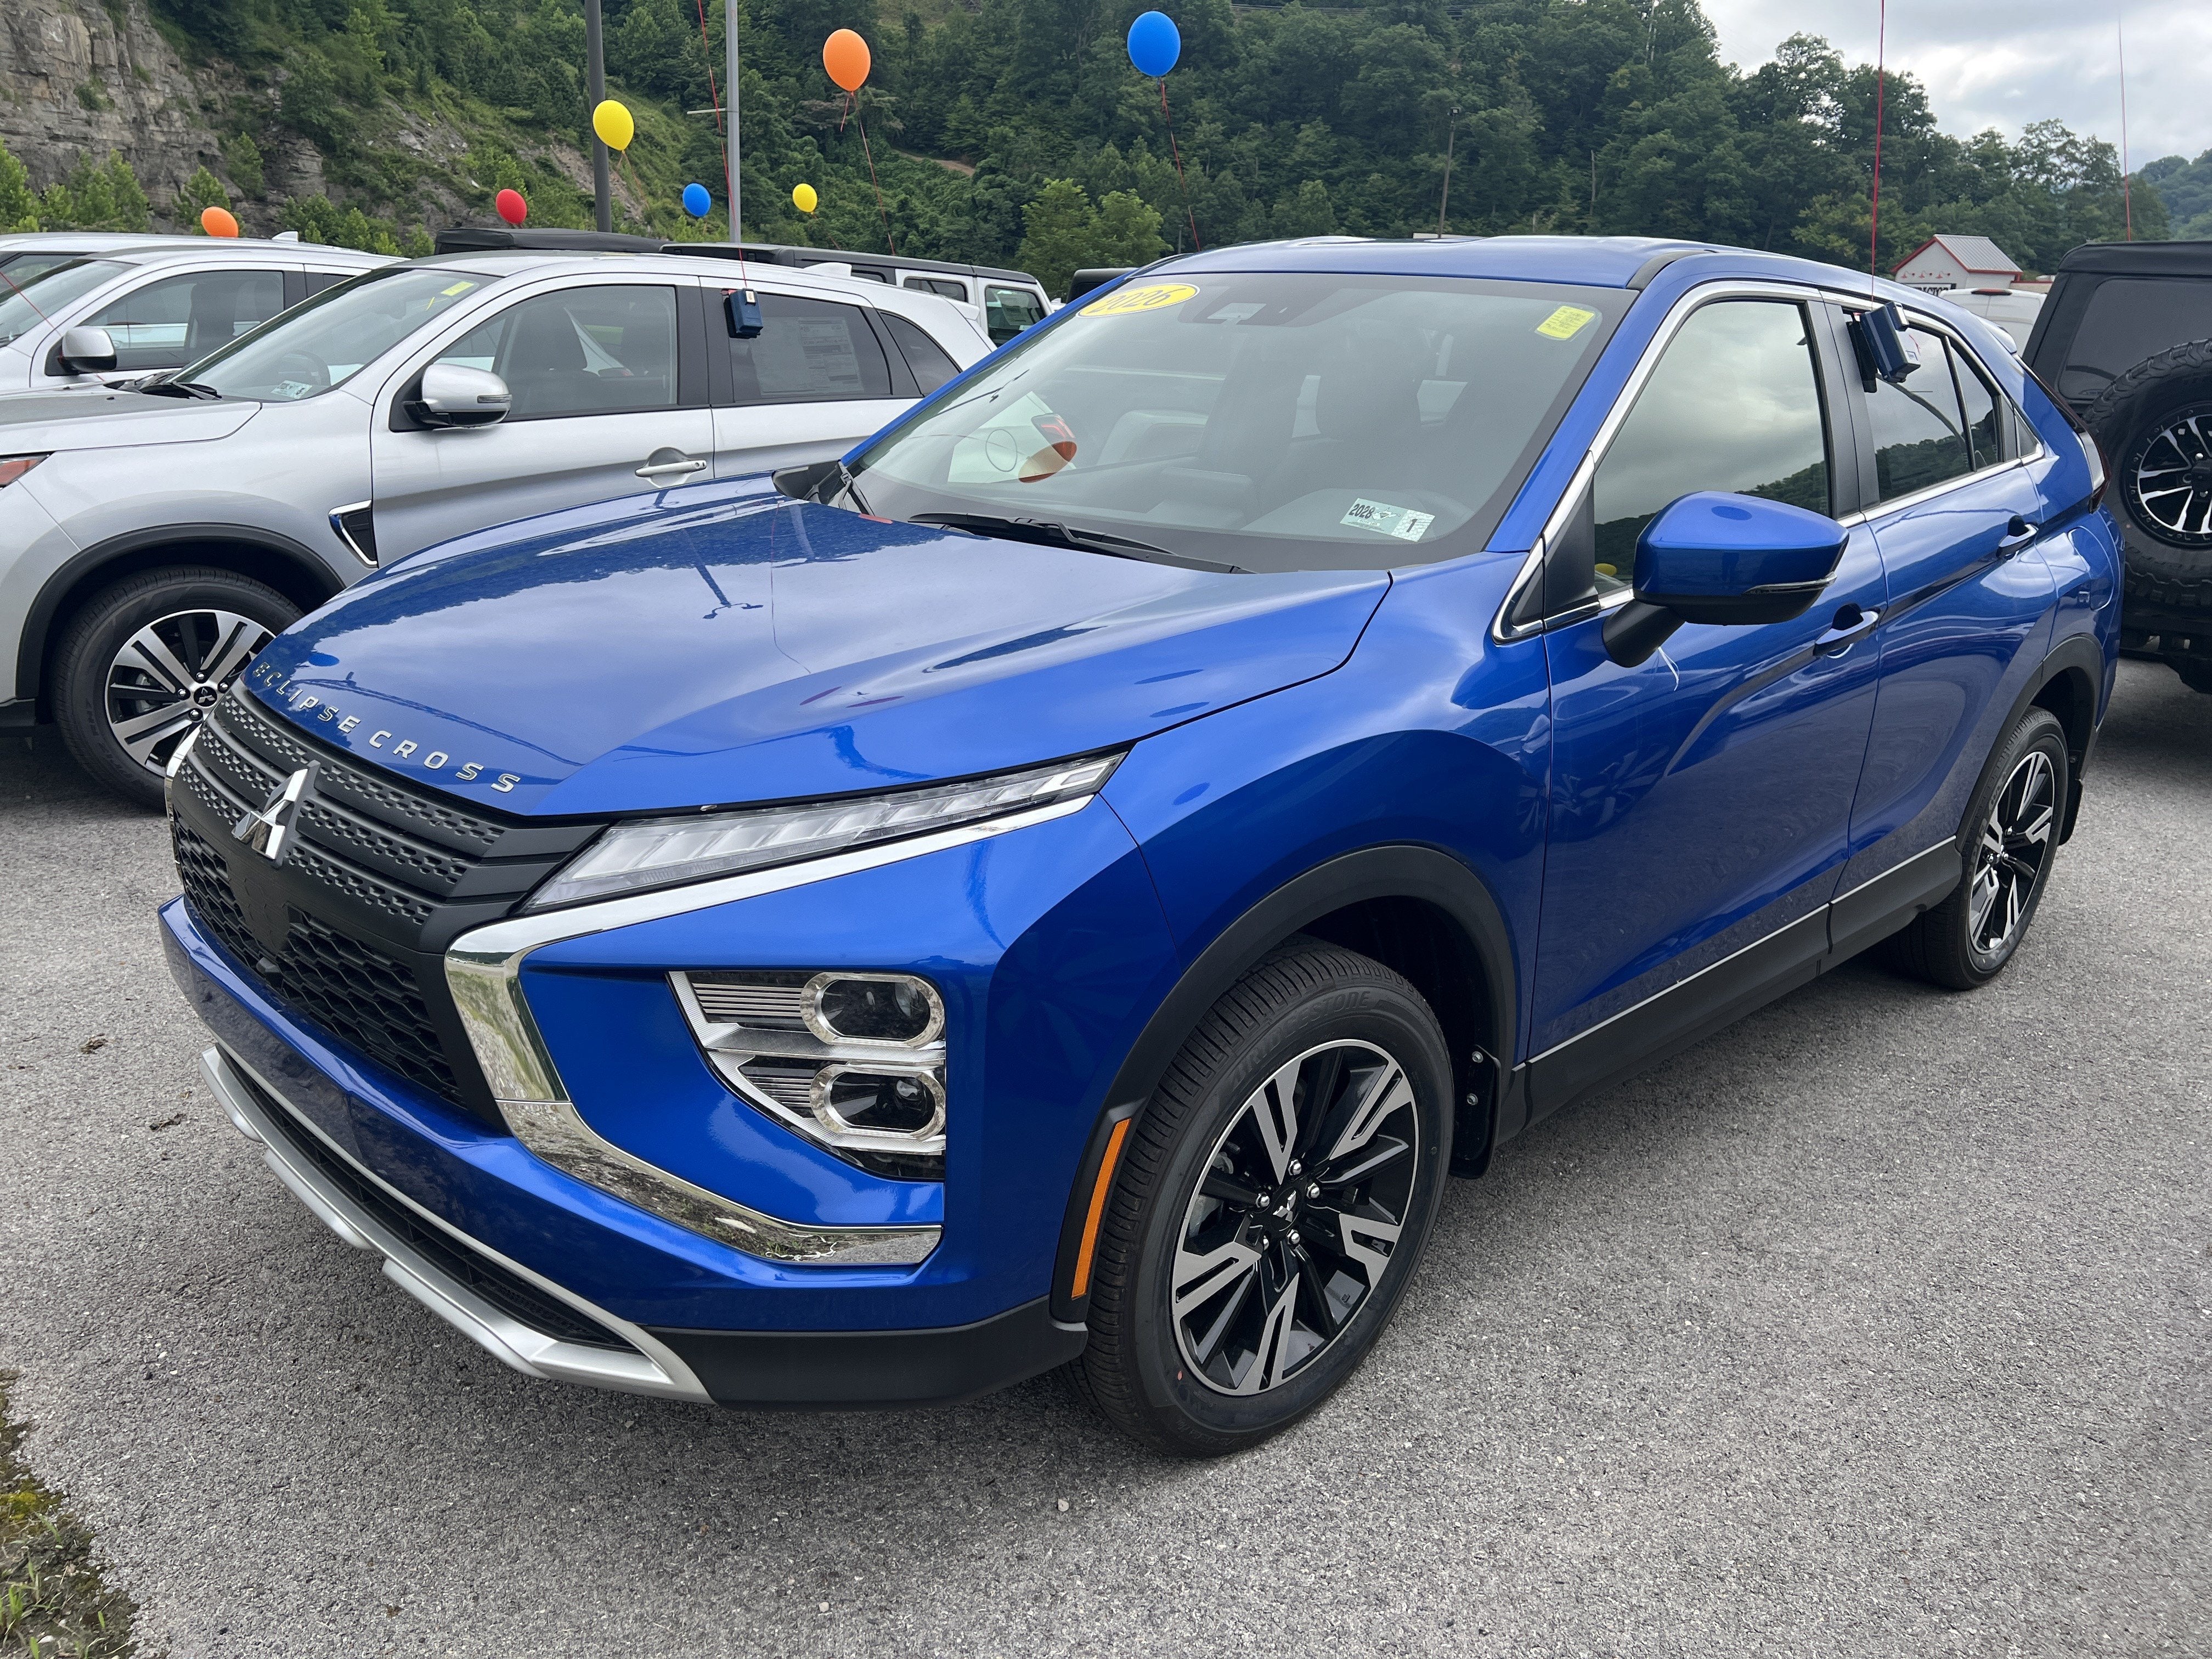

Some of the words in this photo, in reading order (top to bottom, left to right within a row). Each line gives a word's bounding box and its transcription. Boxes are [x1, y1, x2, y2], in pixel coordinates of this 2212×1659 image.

[1087, 288, 1187, 313] 2026
[1348, 504, 1376, 519] 2028
[1406, 518, 1418, 533] 1
[252, 662, 362, 733] ECLIPSE
[369, 730, 521, 793] CROSS
